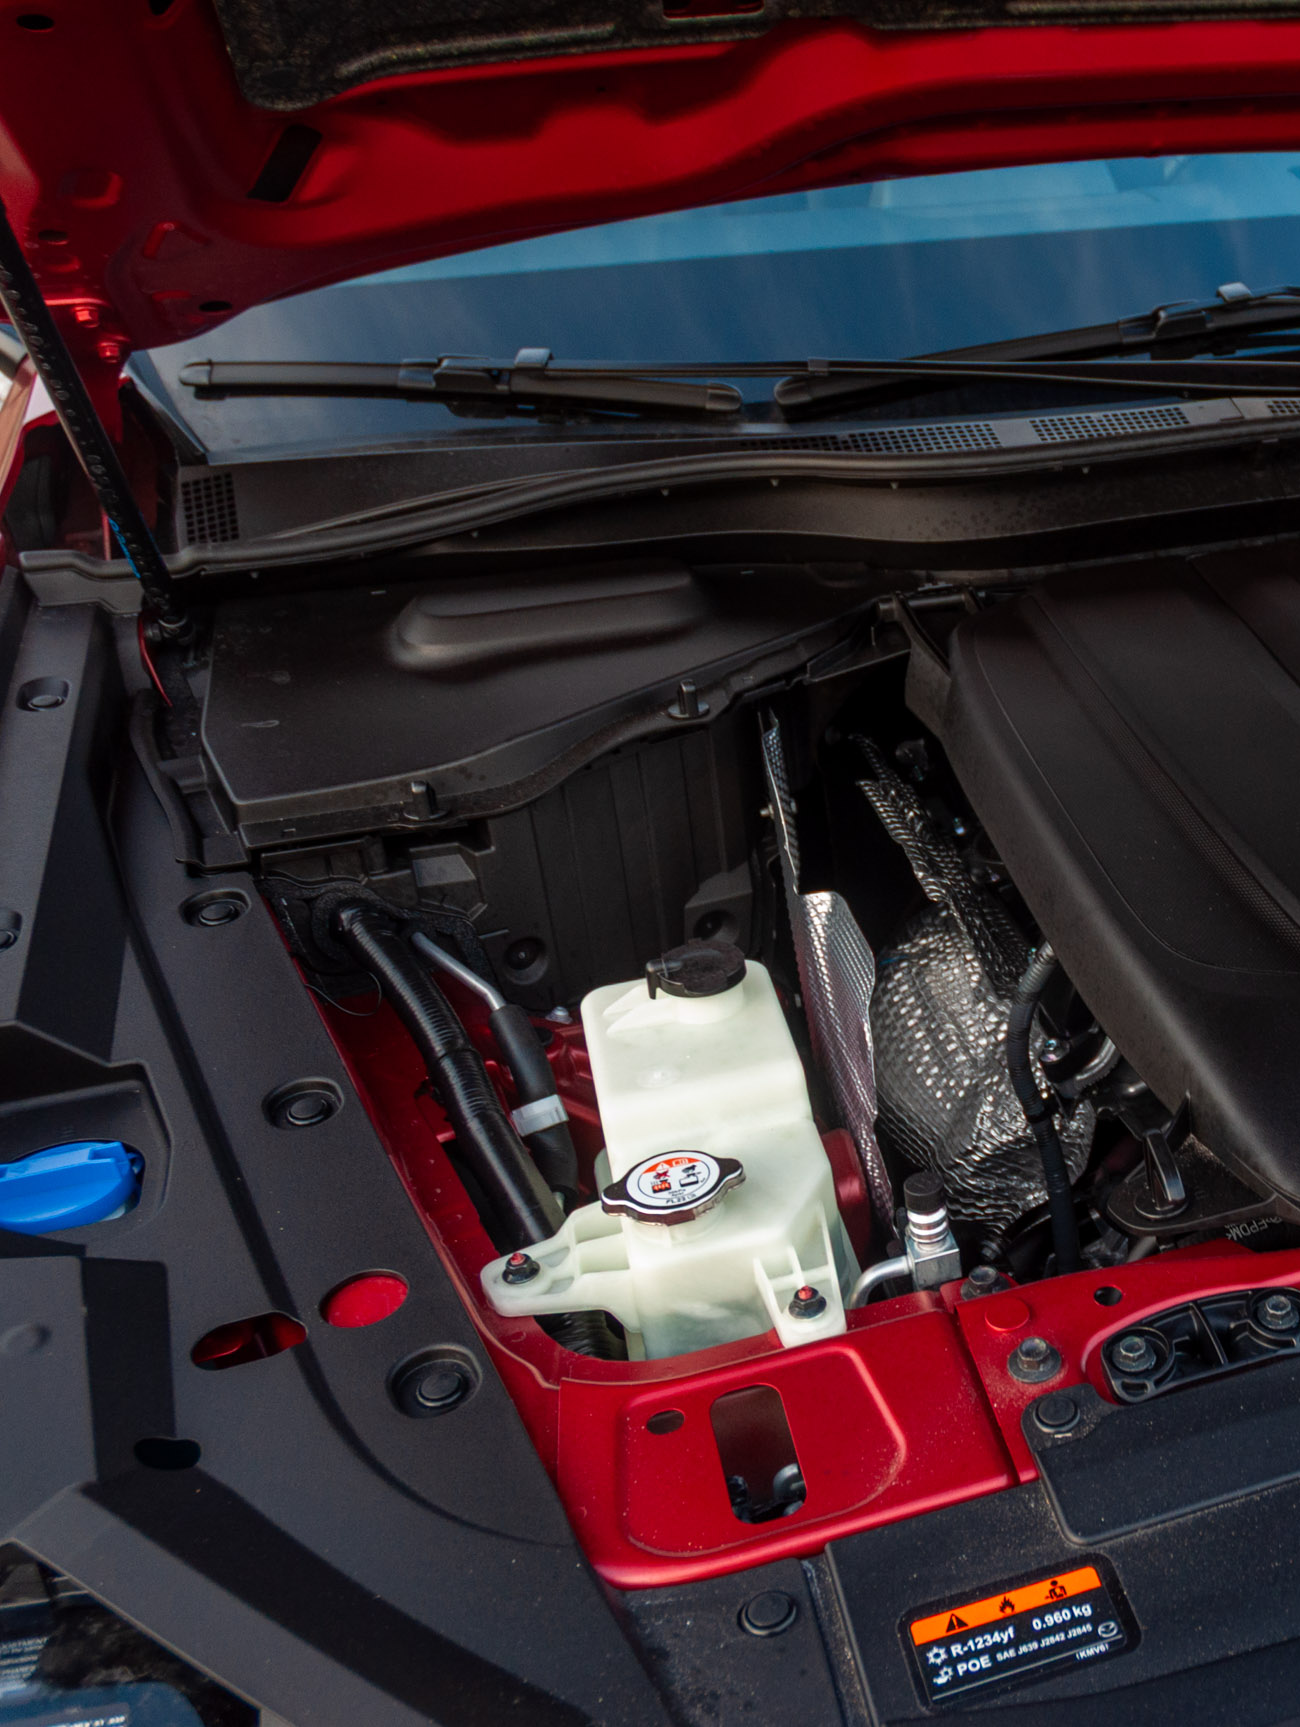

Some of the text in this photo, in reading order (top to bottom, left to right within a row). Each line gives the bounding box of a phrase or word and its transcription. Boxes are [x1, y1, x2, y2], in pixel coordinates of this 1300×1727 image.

[950, 1603, 1093, 1657] R-1234yf 0.960 kg
[956, 1654, 992, 1677] POE
[996, 1649, 1016, 1662] SAE
[1017, 1641, 1039, 1656] J639
[1039, 1632, 1067, 1648] J2842
